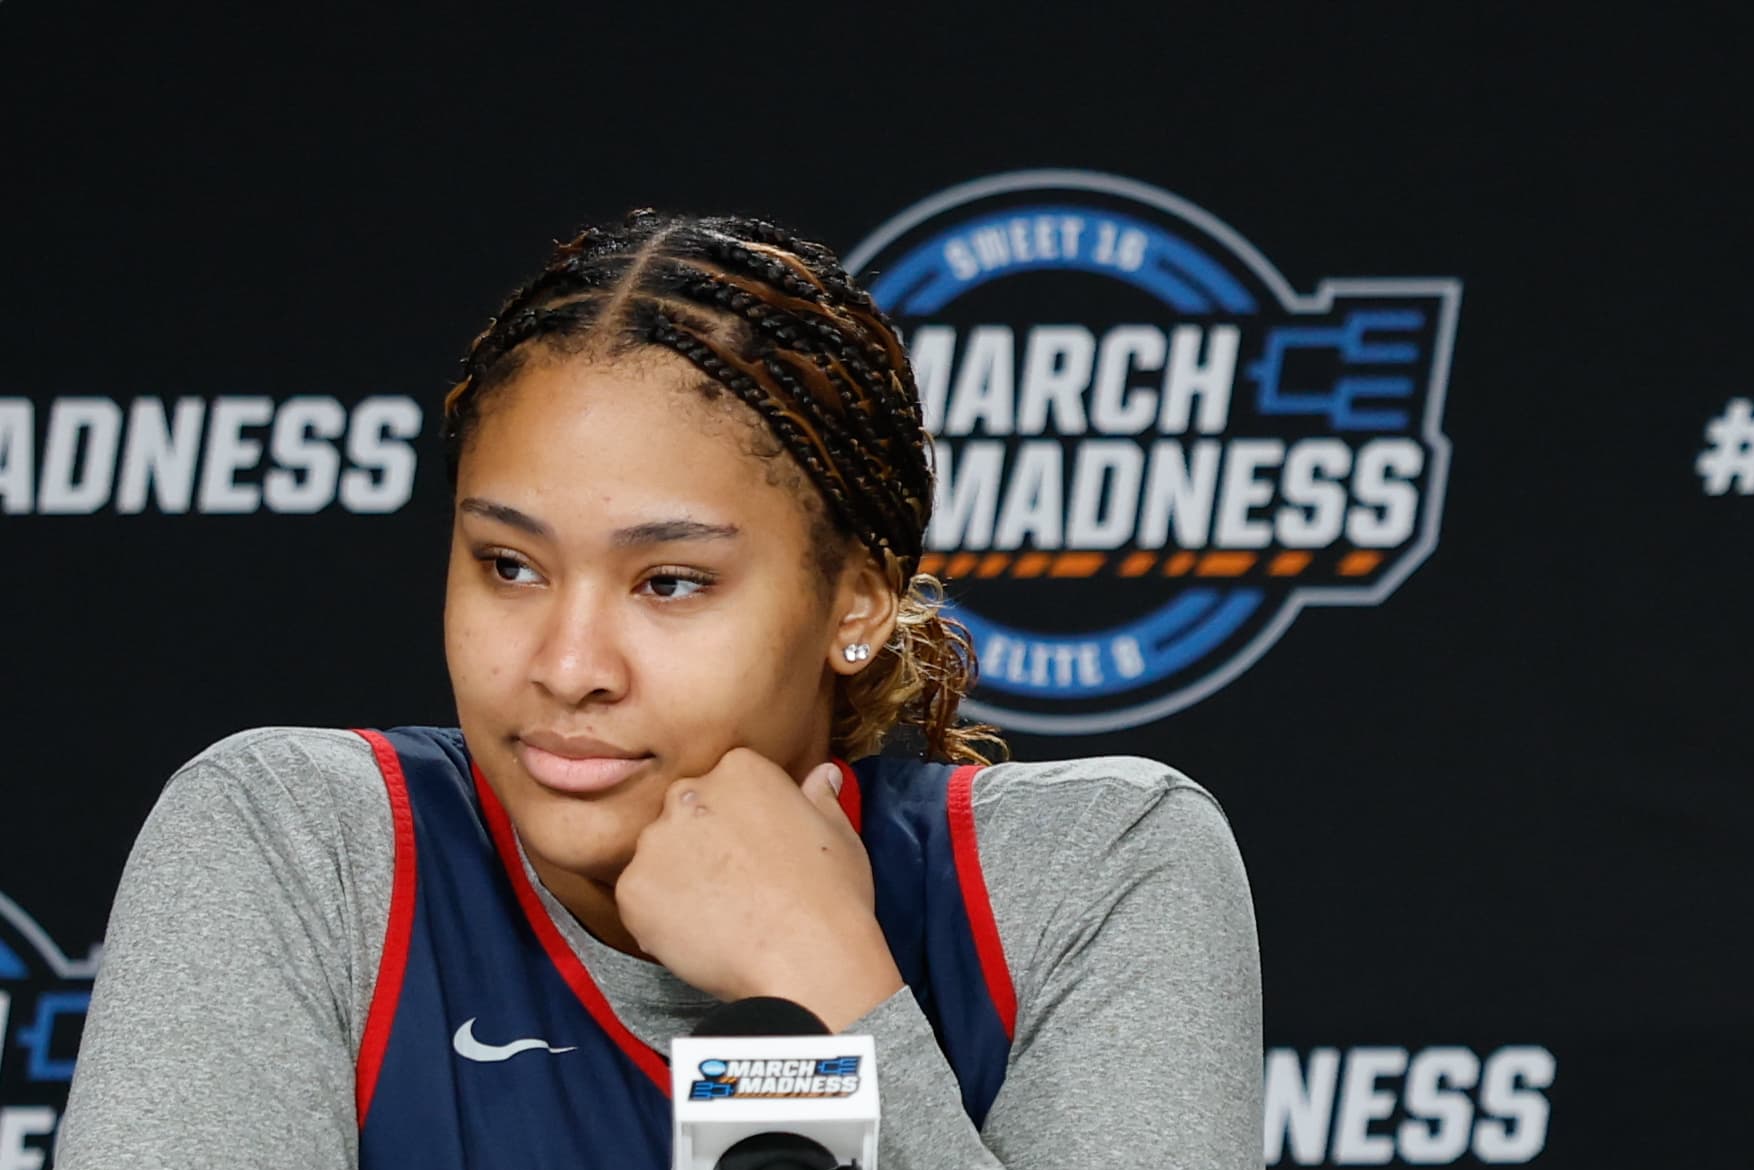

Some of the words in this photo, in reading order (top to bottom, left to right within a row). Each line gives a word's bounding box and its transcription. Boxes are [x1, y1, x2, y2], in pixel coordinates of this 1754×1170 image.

[945, 218, 1084, 281] SWEET
[1094, 224, 1148, 271] 16
[922, 440, 1425, 550] MADNESS
[983, 634, 1103, 687] ELITE
[727, 1060, 817, 1077] MARCH
[738, 1076, 859, 1095] MADNESS
